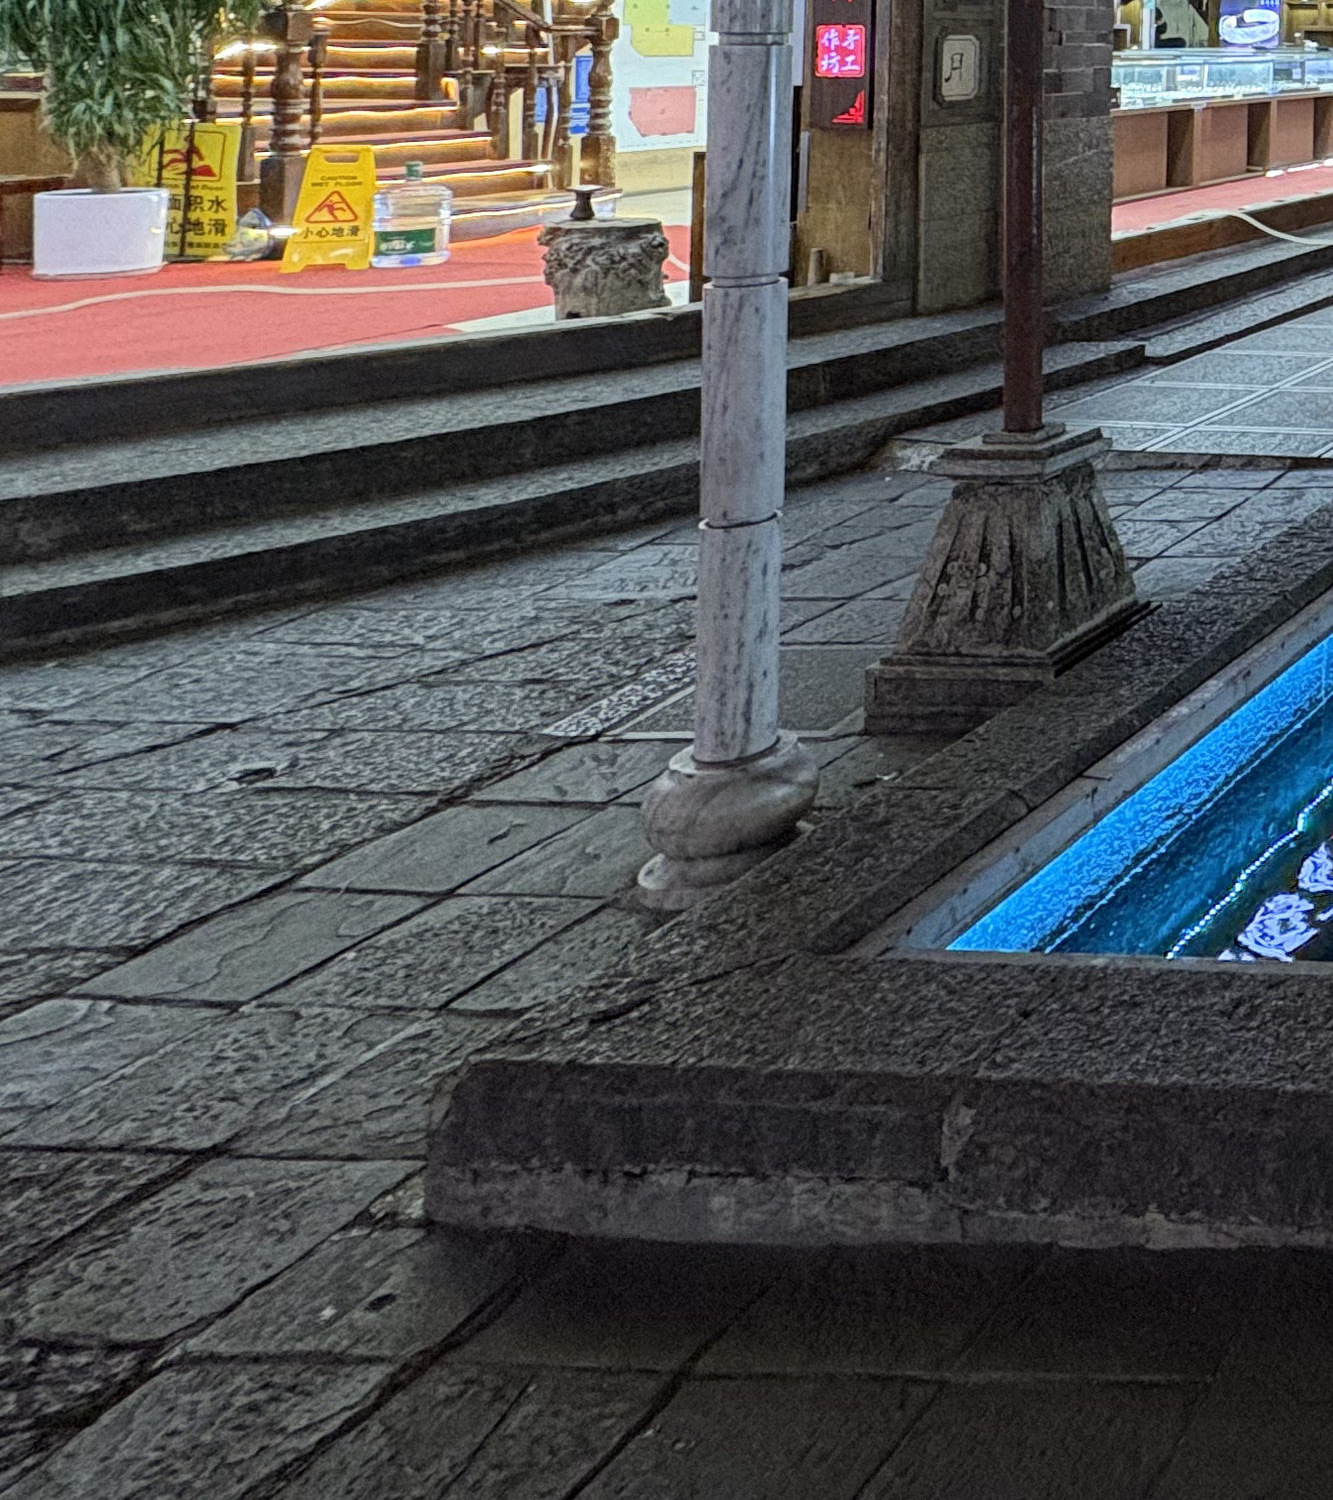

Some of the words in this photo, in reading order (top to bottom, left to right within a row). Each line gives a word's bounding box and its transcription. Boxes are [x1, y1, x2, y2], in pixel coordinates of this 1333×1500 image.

[944, 52, 967, 84] 月
[167, 194, 228, 213] 面积水
[166, 217, 228, 237] 心地滑
[302, 226, 361, 240] 小心地滑
